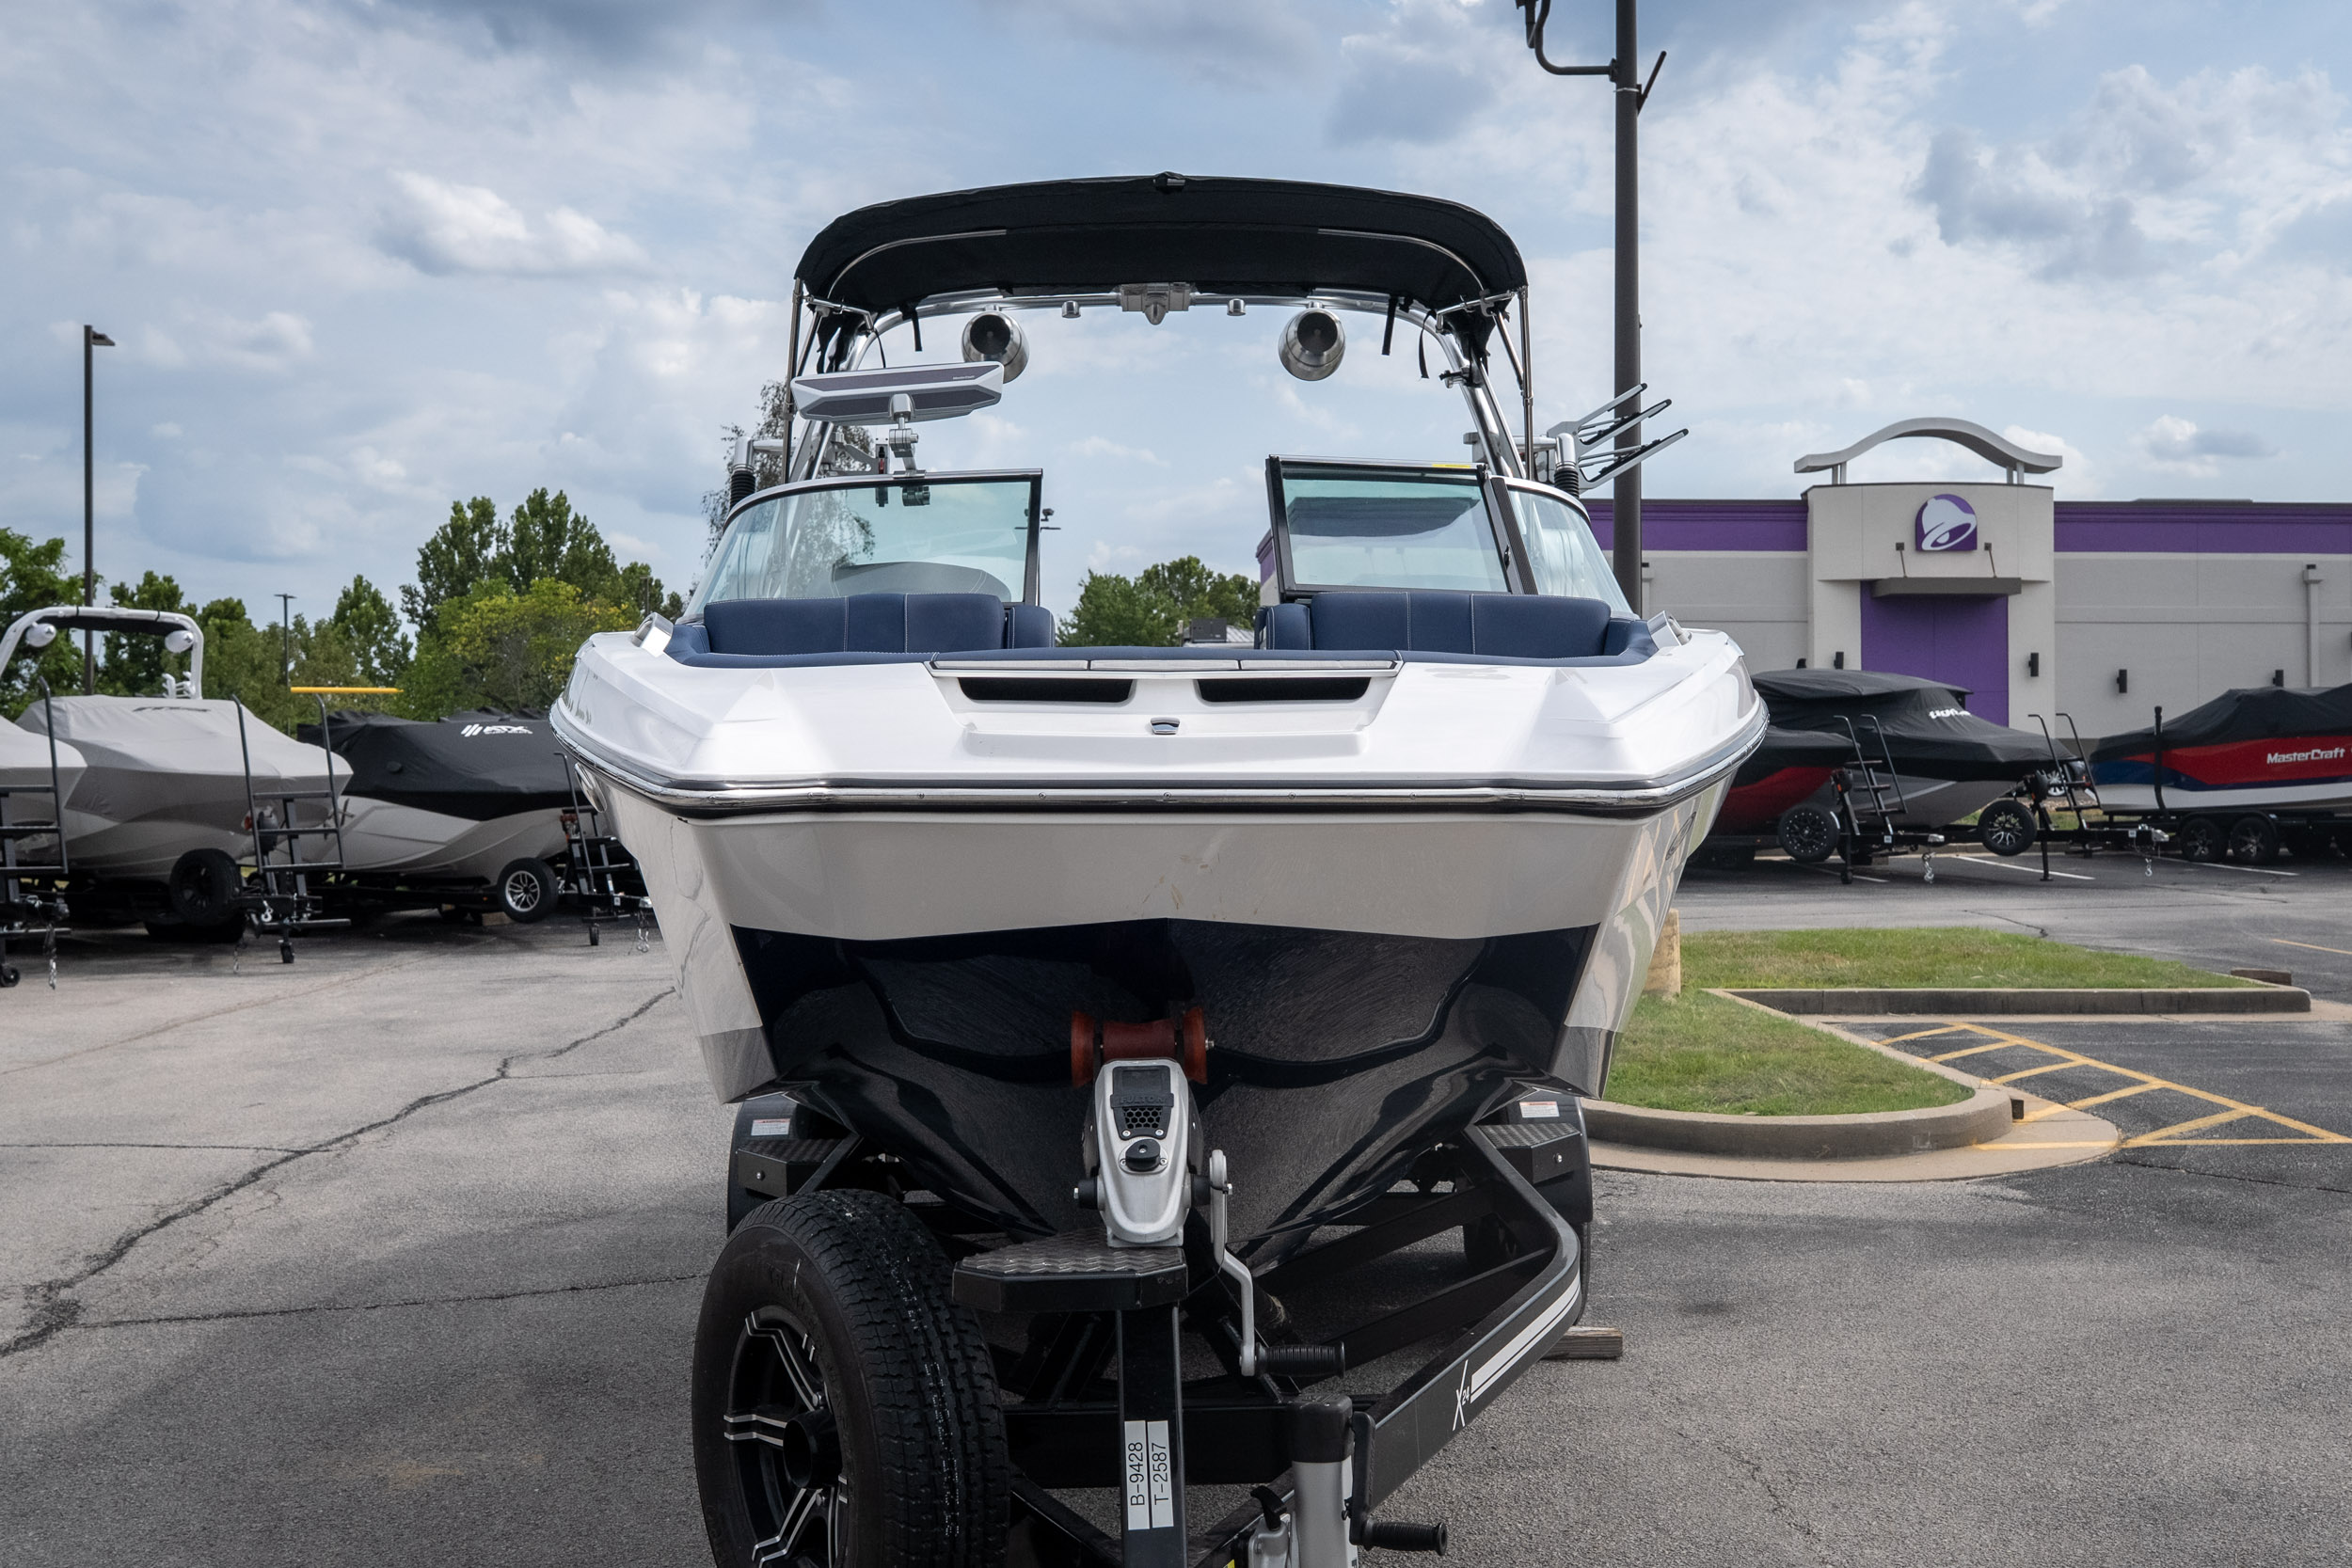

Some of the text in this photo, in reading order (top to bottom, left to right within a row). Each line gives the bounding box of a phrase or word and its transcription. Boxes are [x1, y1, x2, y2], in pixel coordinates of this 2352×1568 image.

[2266, 747, 2345, 765] MasterCraft
[1120, 1095, 1167, 1104] FULTON
[1128, 1442, 1145, 1506] B-9428
[1152, 1442, 1168, 1506] T-2587
